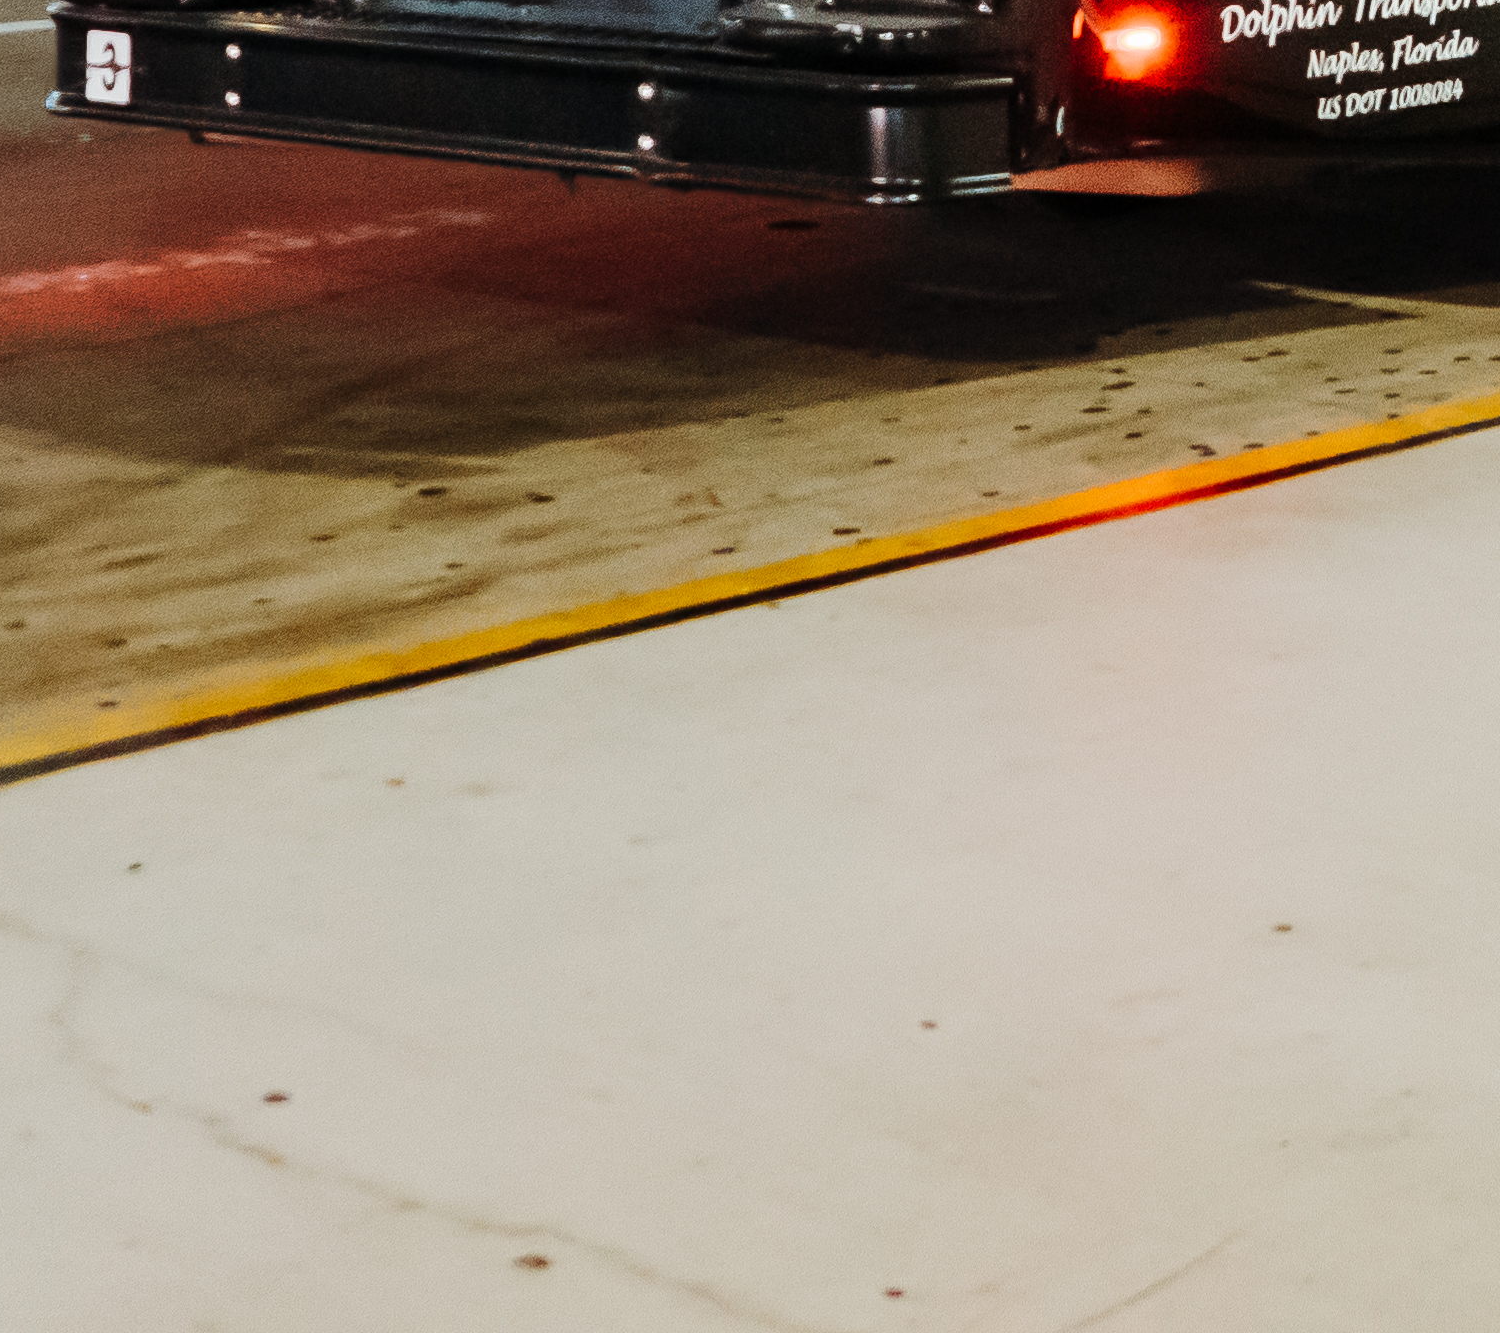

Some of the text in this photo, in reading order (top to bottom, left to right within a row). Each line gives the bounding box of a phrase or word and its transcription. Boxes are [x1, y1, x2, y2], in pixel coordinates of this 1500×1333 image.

[1307, 29, 1480, 83] Naples, Florida
[1317, 78, 1464, 121] US DOT 1008084
